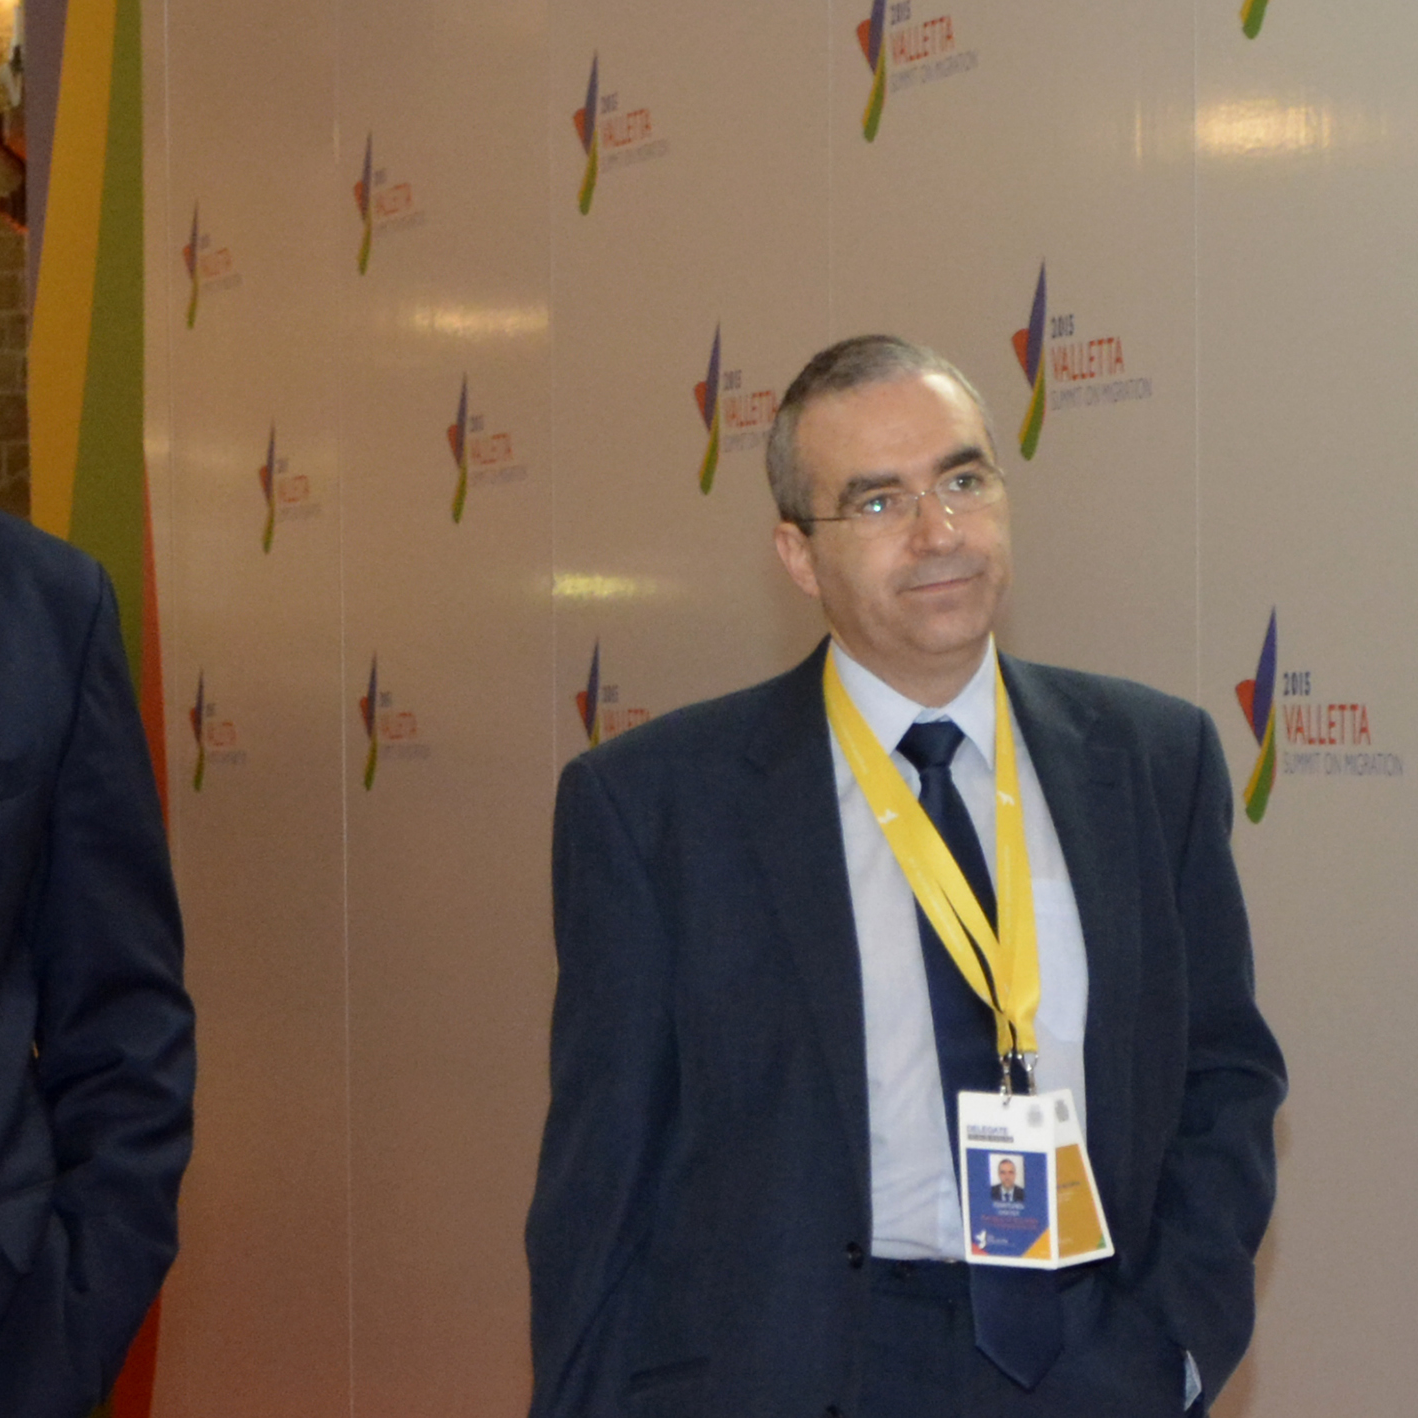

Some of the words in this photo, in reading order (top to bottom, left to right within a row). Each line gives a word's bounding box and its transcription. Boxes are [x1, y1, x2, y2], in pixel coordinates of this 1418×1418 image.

[1051, 336, 1125, 382] VALLETTA
[1283, 671, 1311, 697] 2015
[1283, 704, 1371, 745] VALLETTA
